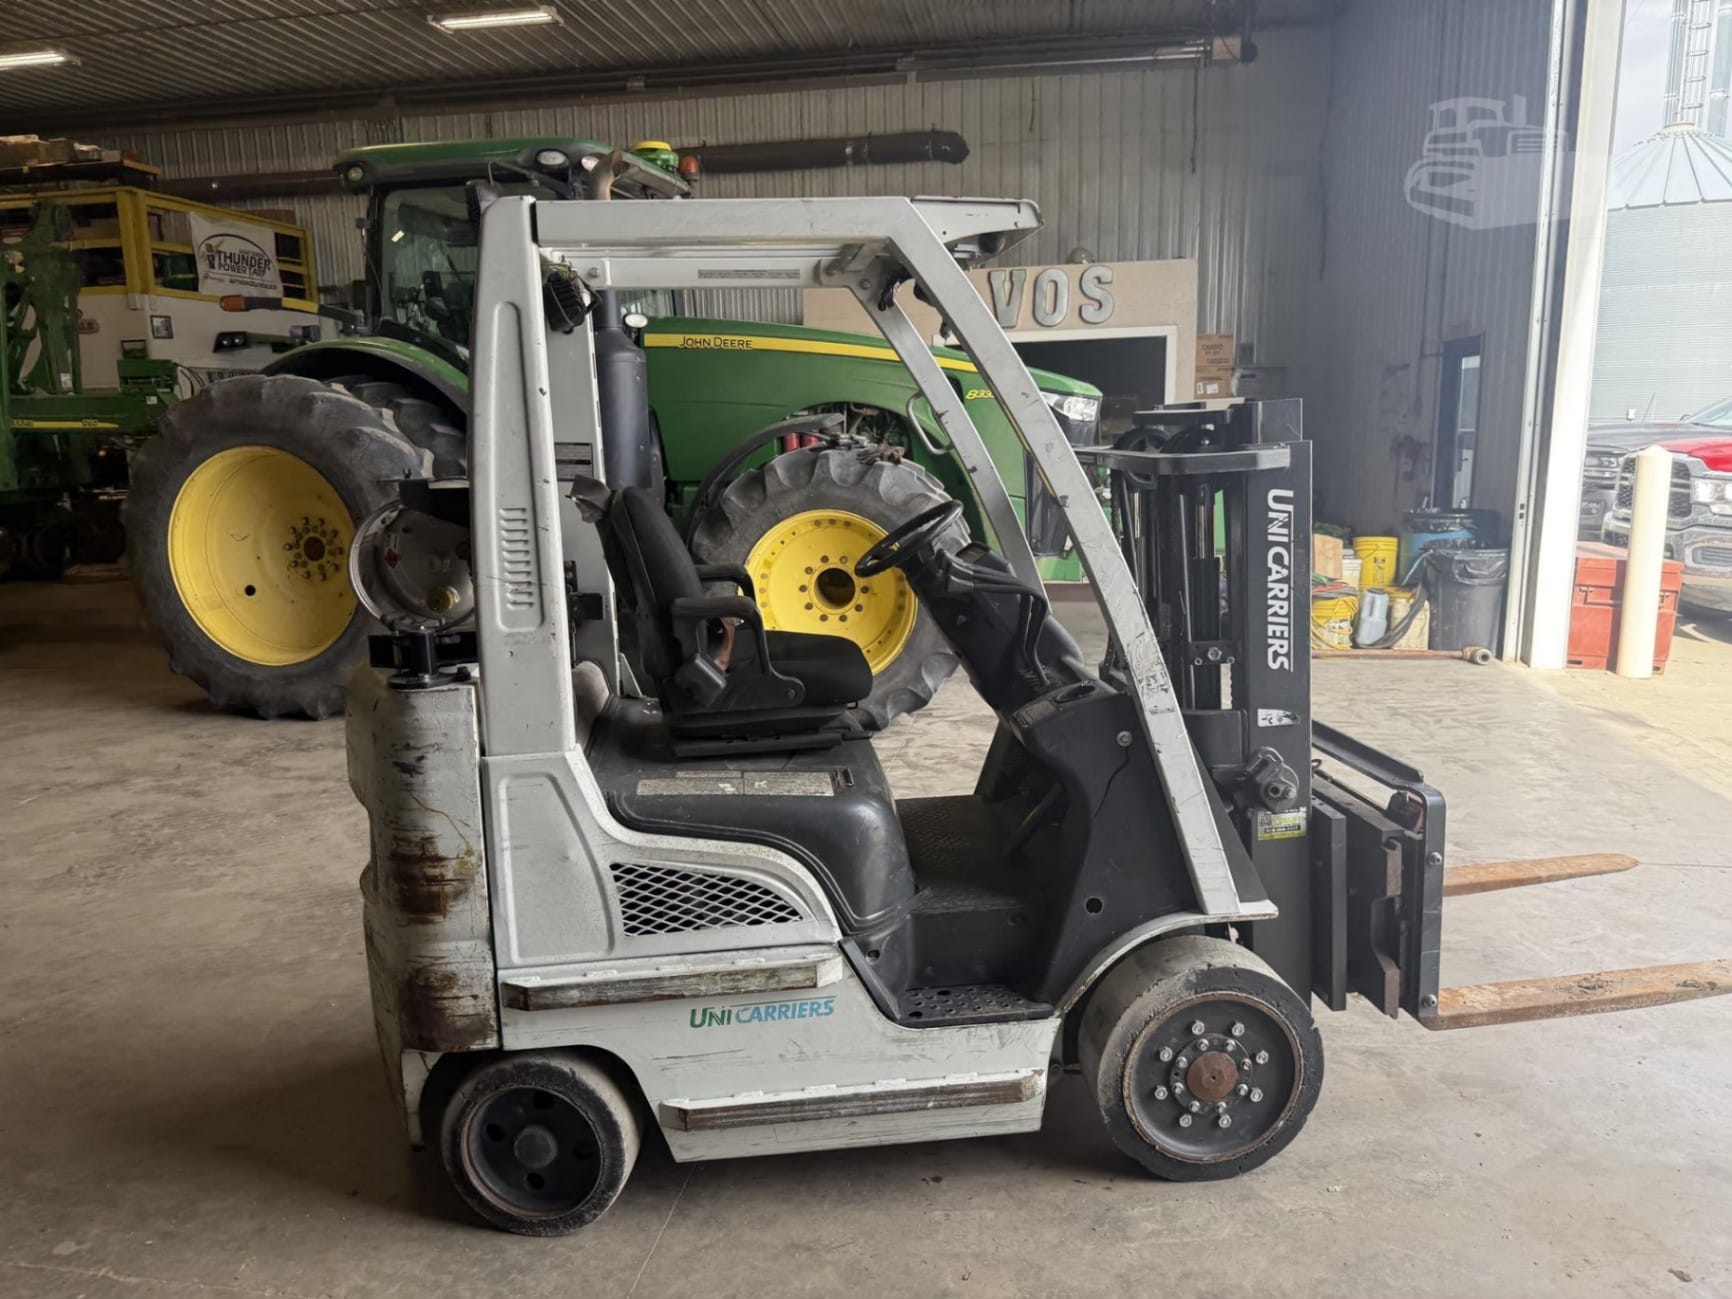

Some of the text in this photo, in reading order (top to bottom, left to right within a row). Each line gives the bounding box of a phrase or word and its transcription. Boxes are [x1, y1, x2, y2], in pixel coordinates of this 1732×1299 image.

[216, 249, 272, 271] THUNDER
[218, 261, 247, 275] POWER
[987, 264, 1115, 328] VOS
[679, 335, 753, 349] JOHN DEERE
